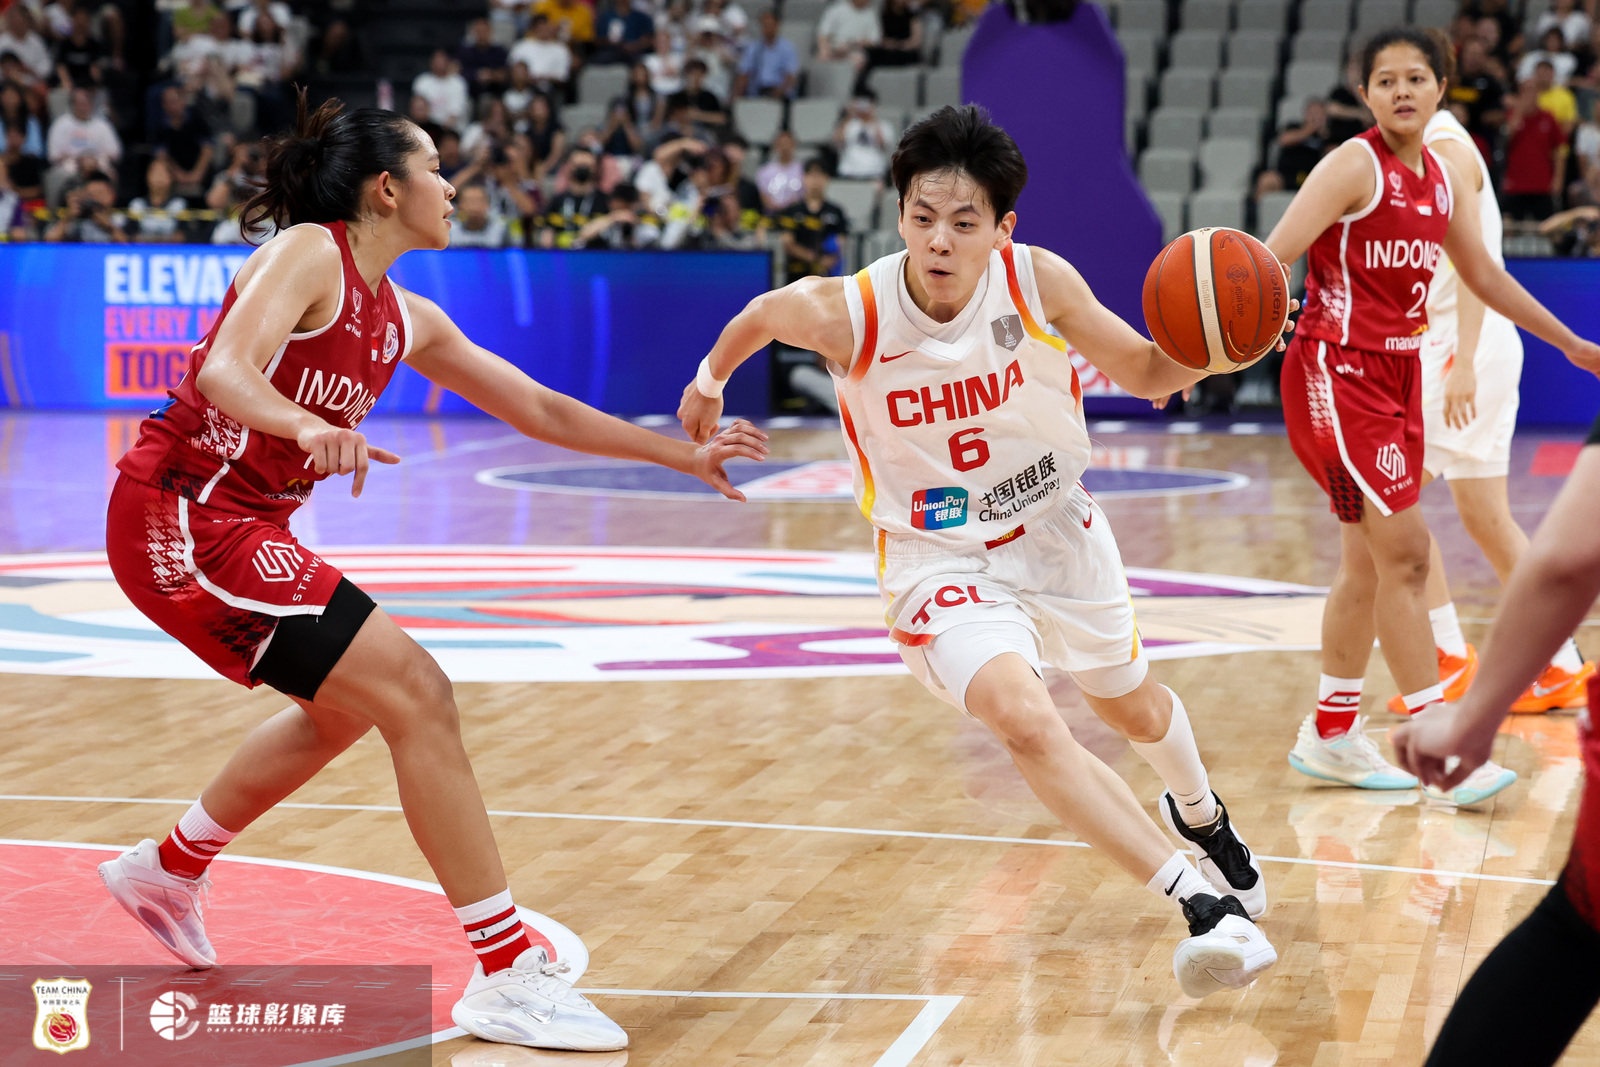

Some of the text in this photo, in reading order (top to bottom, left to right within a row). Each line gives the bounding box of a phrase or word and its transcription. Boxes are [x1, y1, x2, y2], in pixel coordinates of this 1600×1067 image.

[1406, 281, 1427, 319] 2
[105, 306, 190, 338] EVERY
[886, 359, 1025, 428] CHINA
[947, 427, 990, 473] 6
[978, 477, 1060, 523] China UnionPay
[979, 452, 1057, 508] 中国银联
[1383, 476, 1414, 497] STRIVE
[913, 495, 967, 513] UnionPay
[934, 507, 963, 522] 银联
[292, 555, 323, 602] STRIVE
[911, 585, 998, 626] TCL
